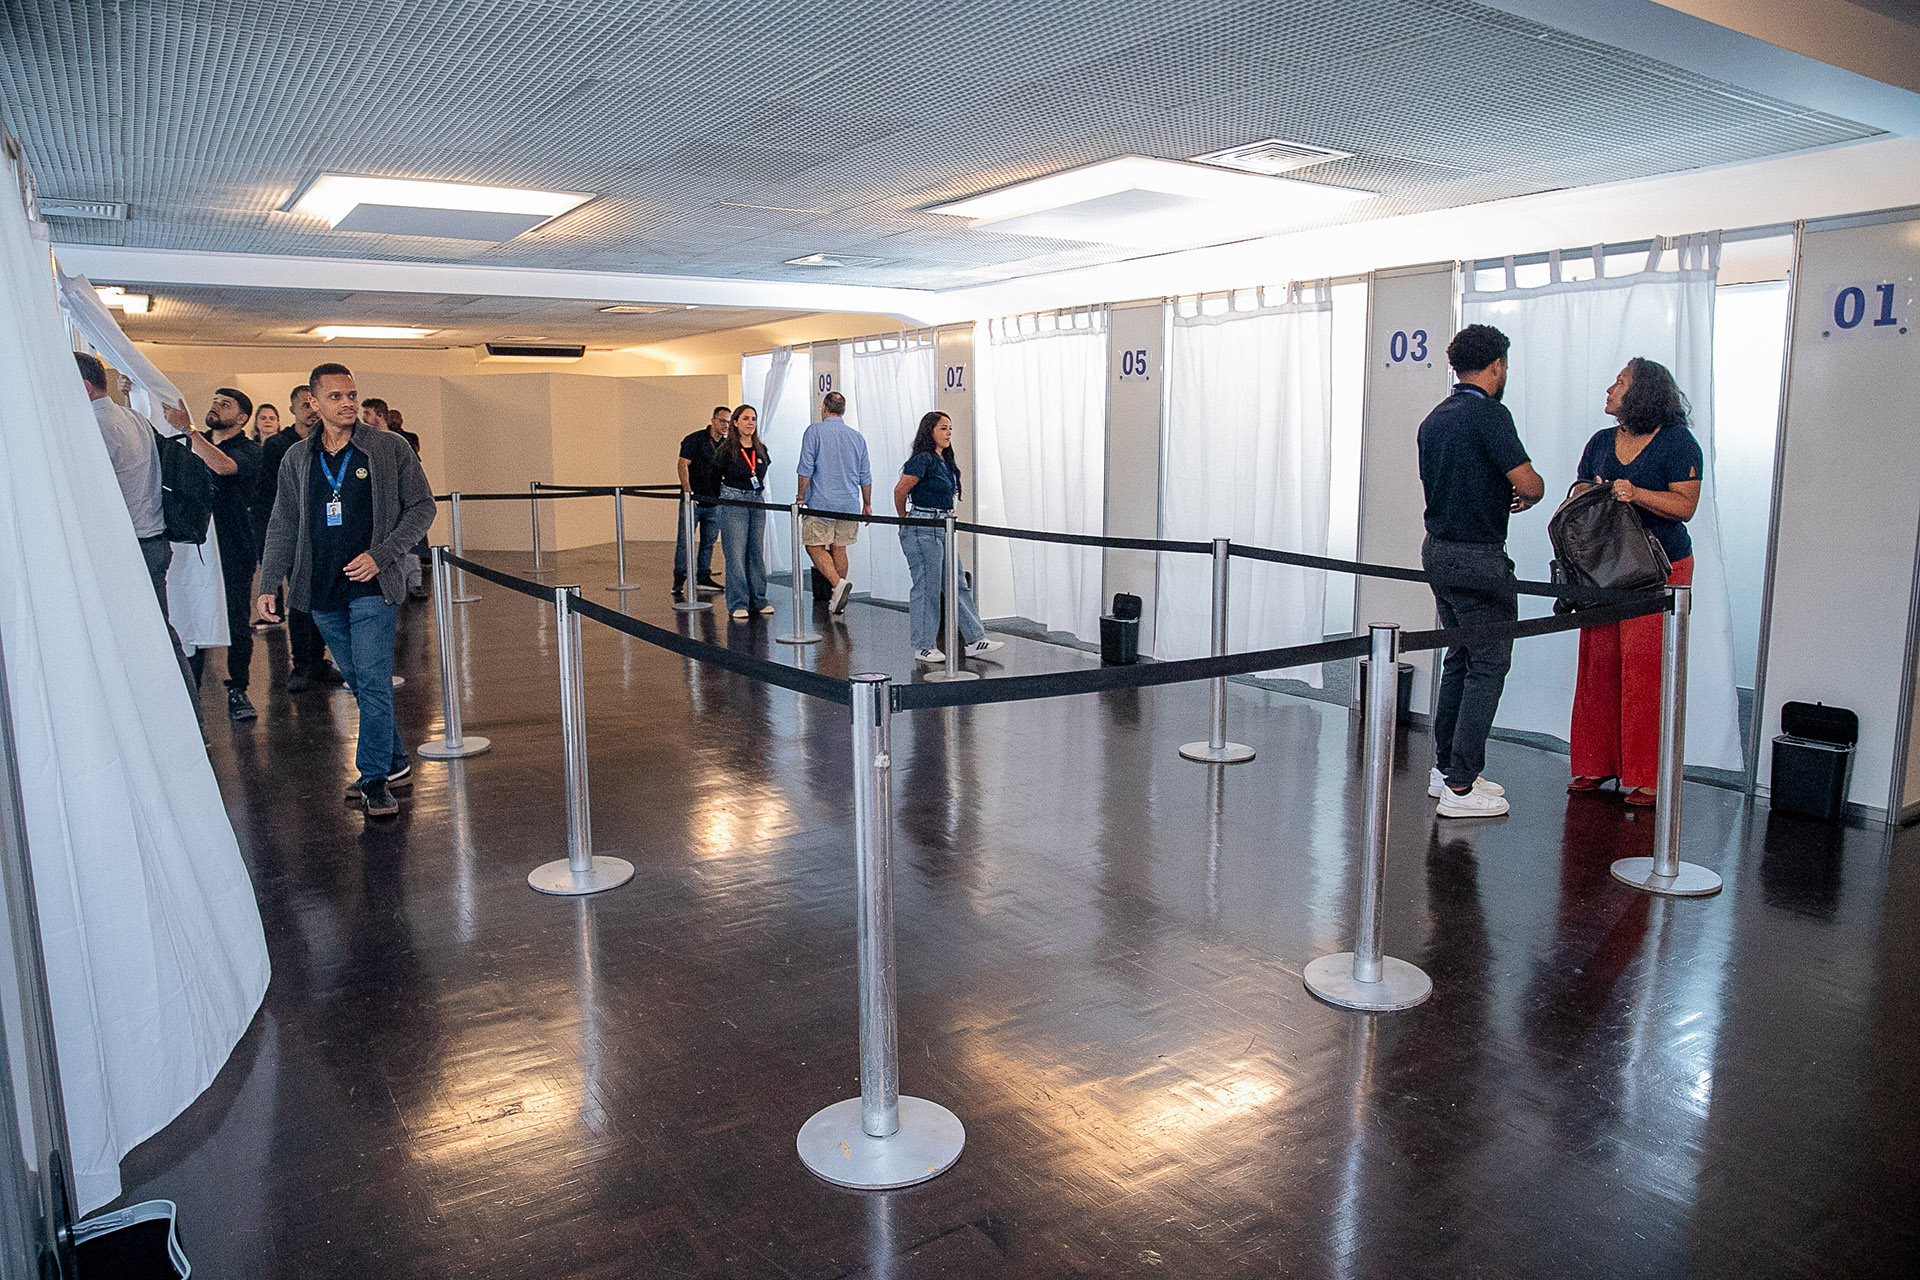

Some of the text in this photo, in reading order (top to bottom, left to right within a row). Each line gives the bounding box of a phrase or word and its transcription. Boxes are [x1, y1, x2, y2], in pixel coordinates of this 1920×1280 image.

[1834, 284, 1897, 329] 01
[1390, 329, 1428, 362] 03
[1122, 350, 1147, 375] 05
[819, 373, 832, 392] 09
[947, 366, 963, 388] 07
